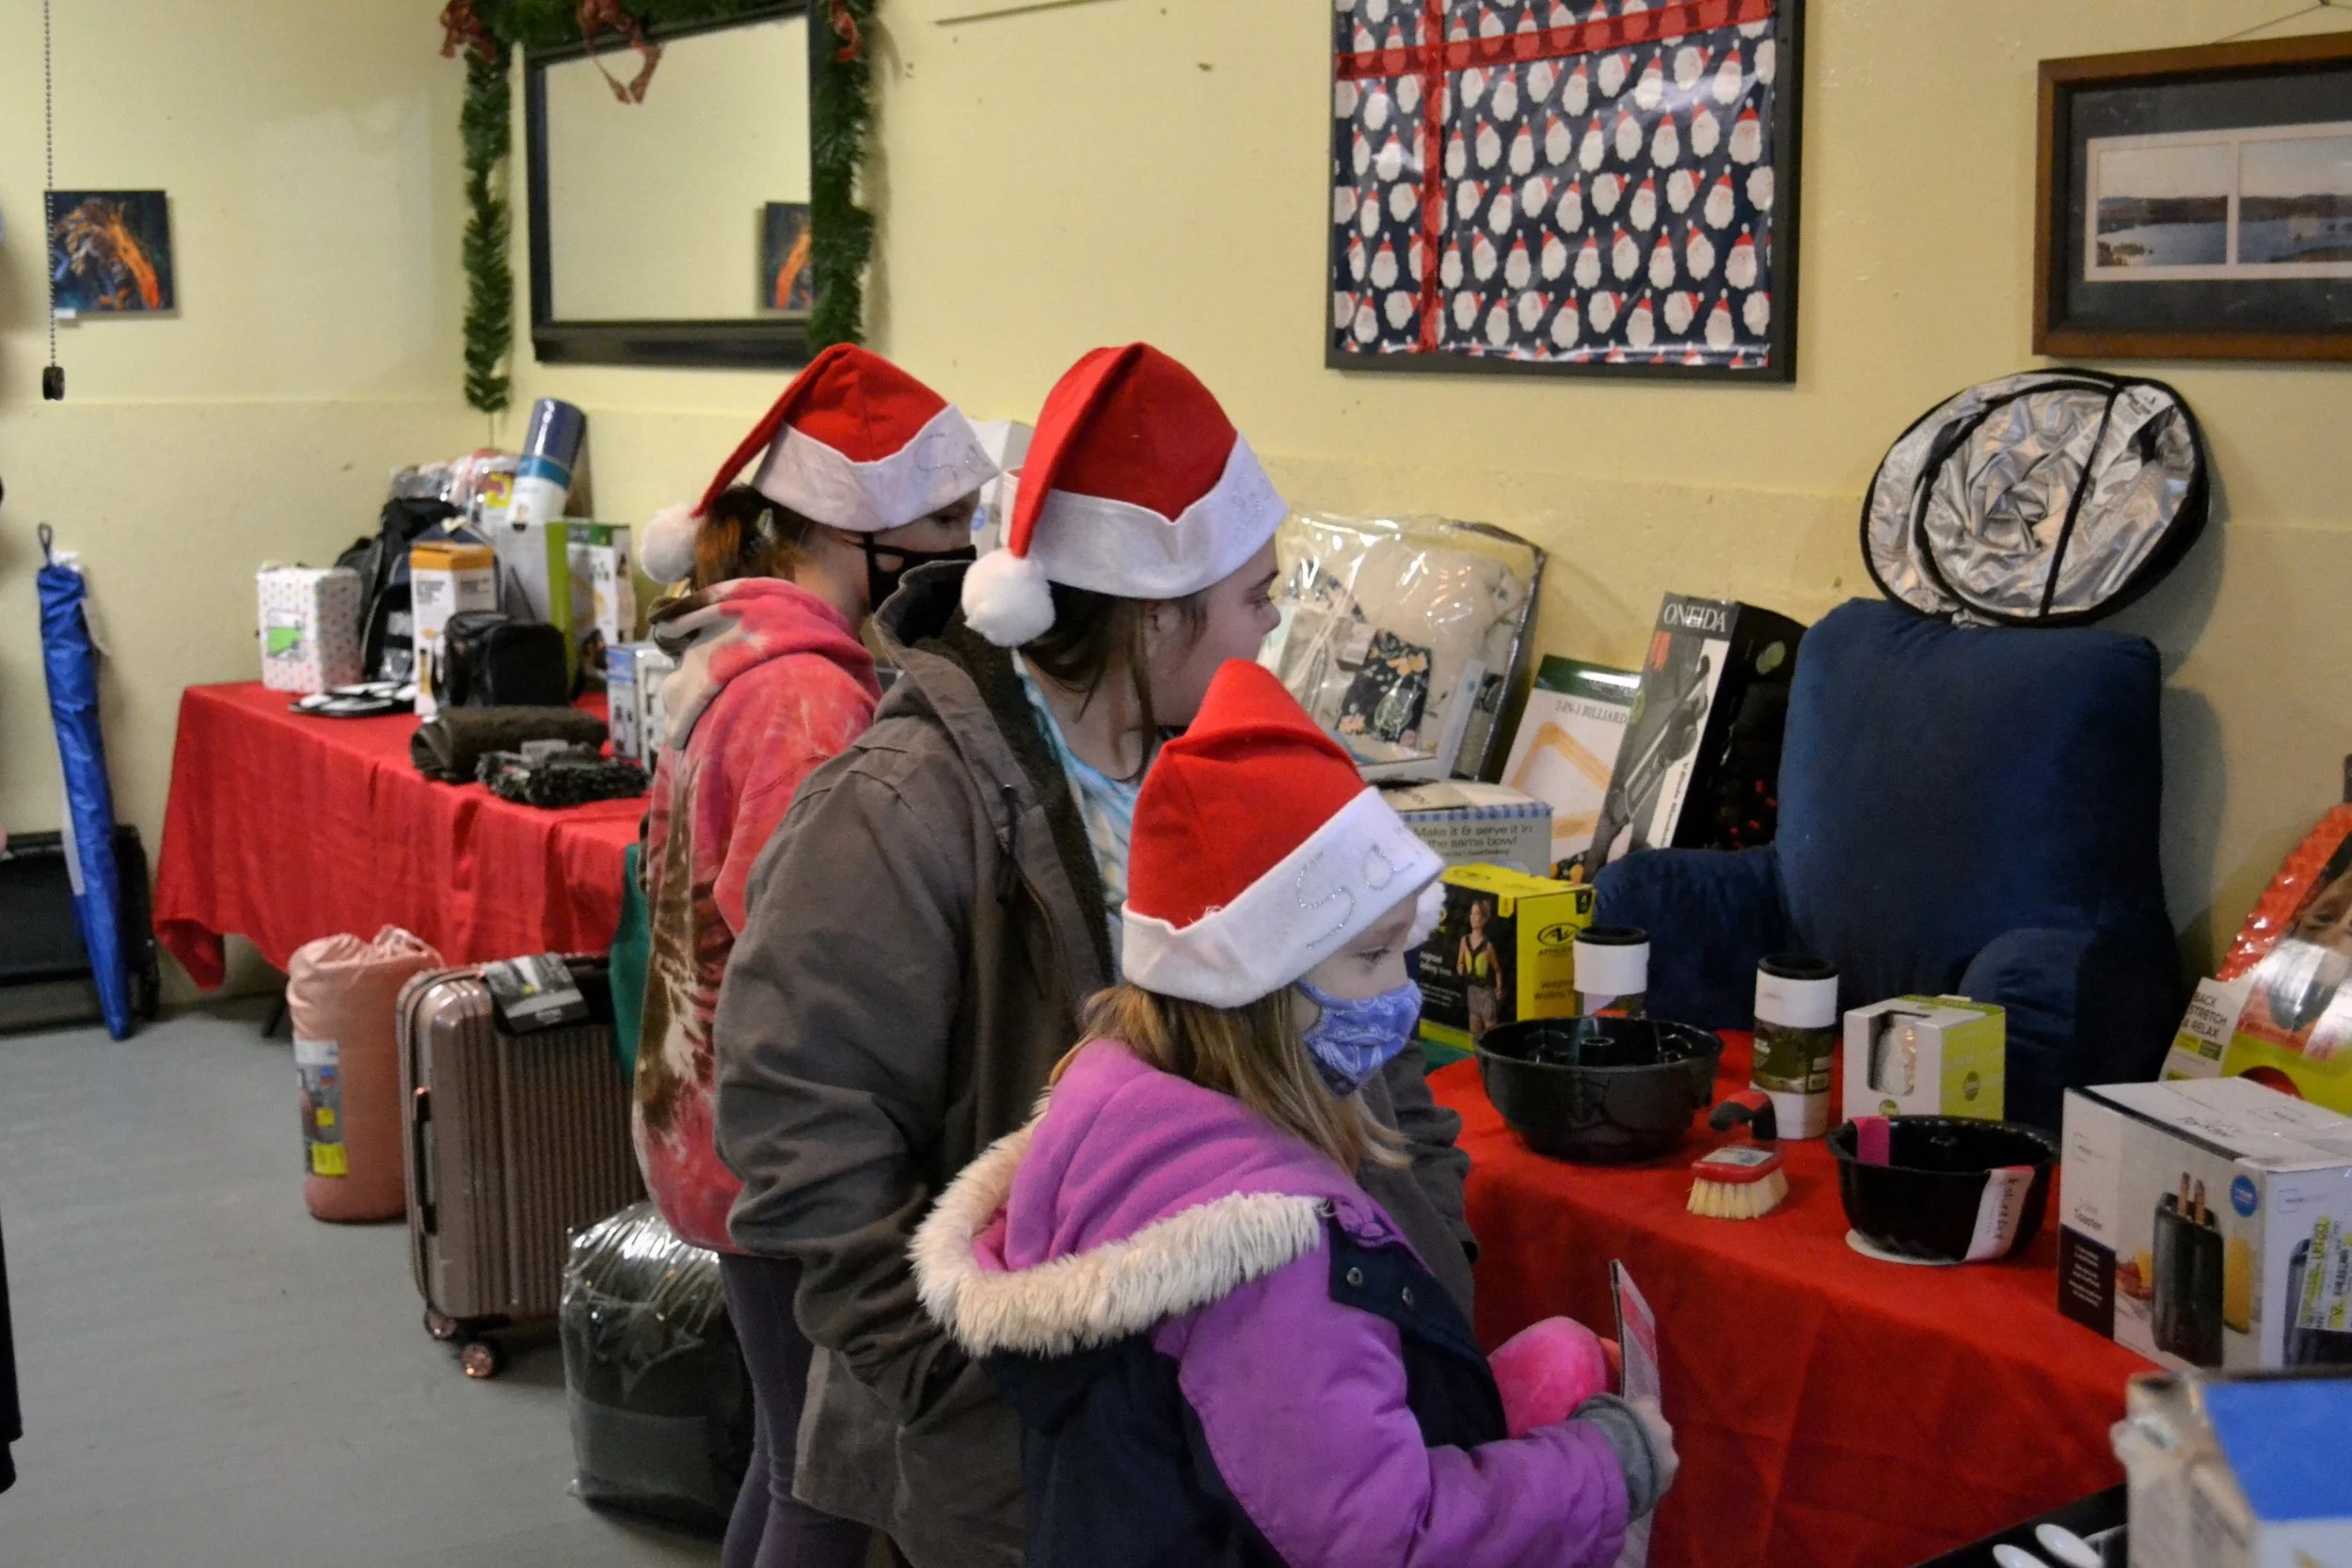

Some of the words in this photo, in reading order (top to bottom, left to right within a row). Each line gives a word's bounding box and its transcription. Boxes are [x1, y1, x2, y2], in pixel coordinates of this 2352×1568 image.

[1663, 602, 1726, 633] ONEIDA
[1413, 827, 1447, 837] Make
[1474, 827, 1507, 836] serve
[1451, 838, 1485, 847] same
[2193, 990, 2218, 1007] BACK
[2187, 1004, 2228, 1026] STRETCH
[2190, 1019, 2220, 1037] RELAX
